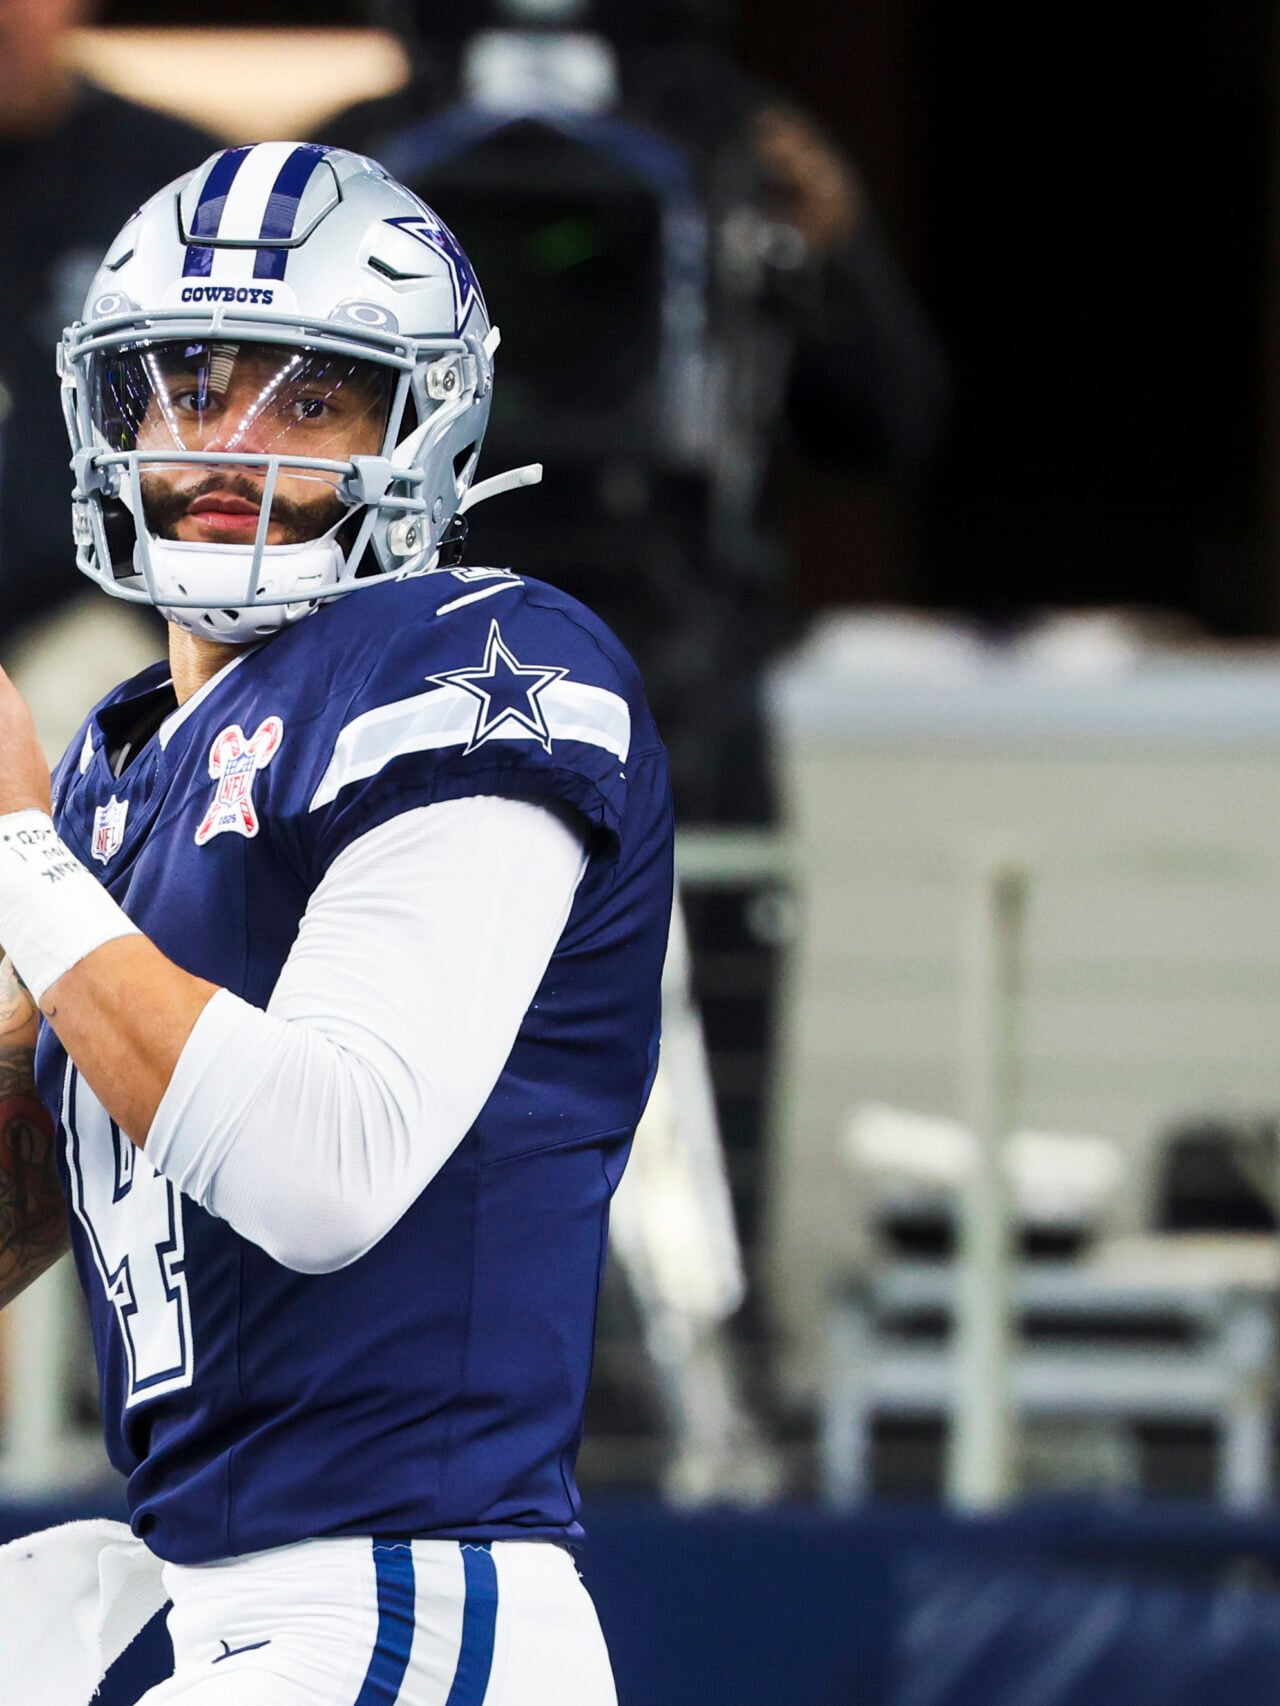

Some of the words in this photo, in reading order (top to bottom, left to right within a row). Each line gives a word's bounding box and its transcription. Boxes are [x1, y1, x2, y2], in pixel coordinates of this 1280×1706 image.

[181, 286, 274, 305] COWBOYS
[221, 774, 246, 801] NFL
[96, 826, 117, 851] NFL
[61, 1053, 194, 1409] 4
